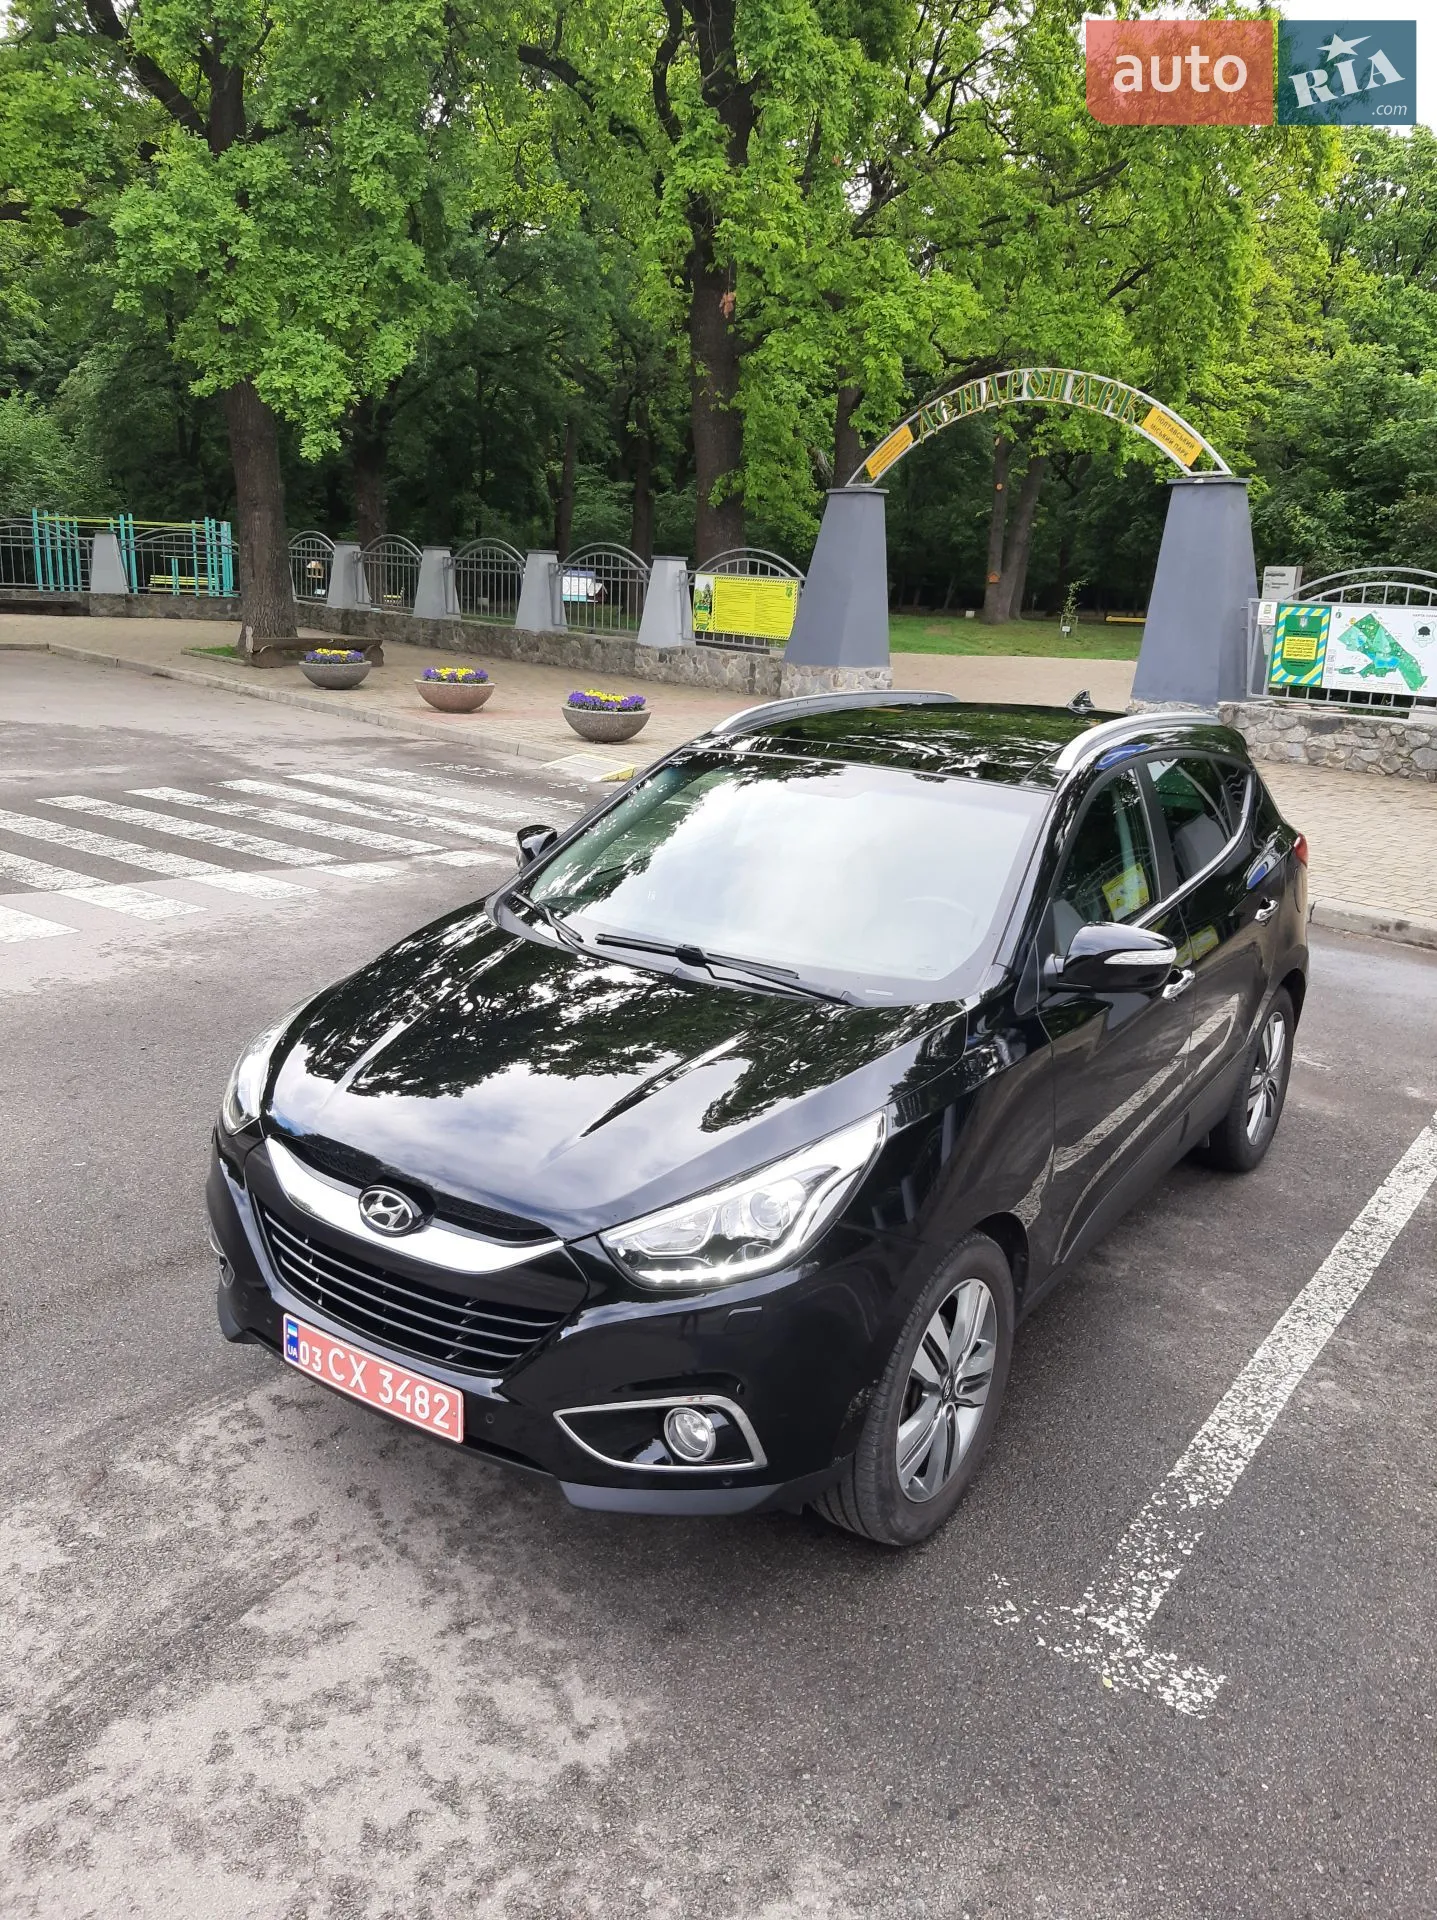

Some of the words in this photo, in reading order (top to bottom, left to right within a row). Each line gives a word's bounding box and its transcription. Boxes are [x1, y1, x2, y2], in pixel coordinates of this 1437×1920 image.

[1173, 443, 1189, 457] ПАРК
[287, 1345, 298, 1359] UA
[299, 1341, 322, 1372] 03
[328, 1347, 368, 1394] CX
[378, 1369, 450, 1429] 3482
